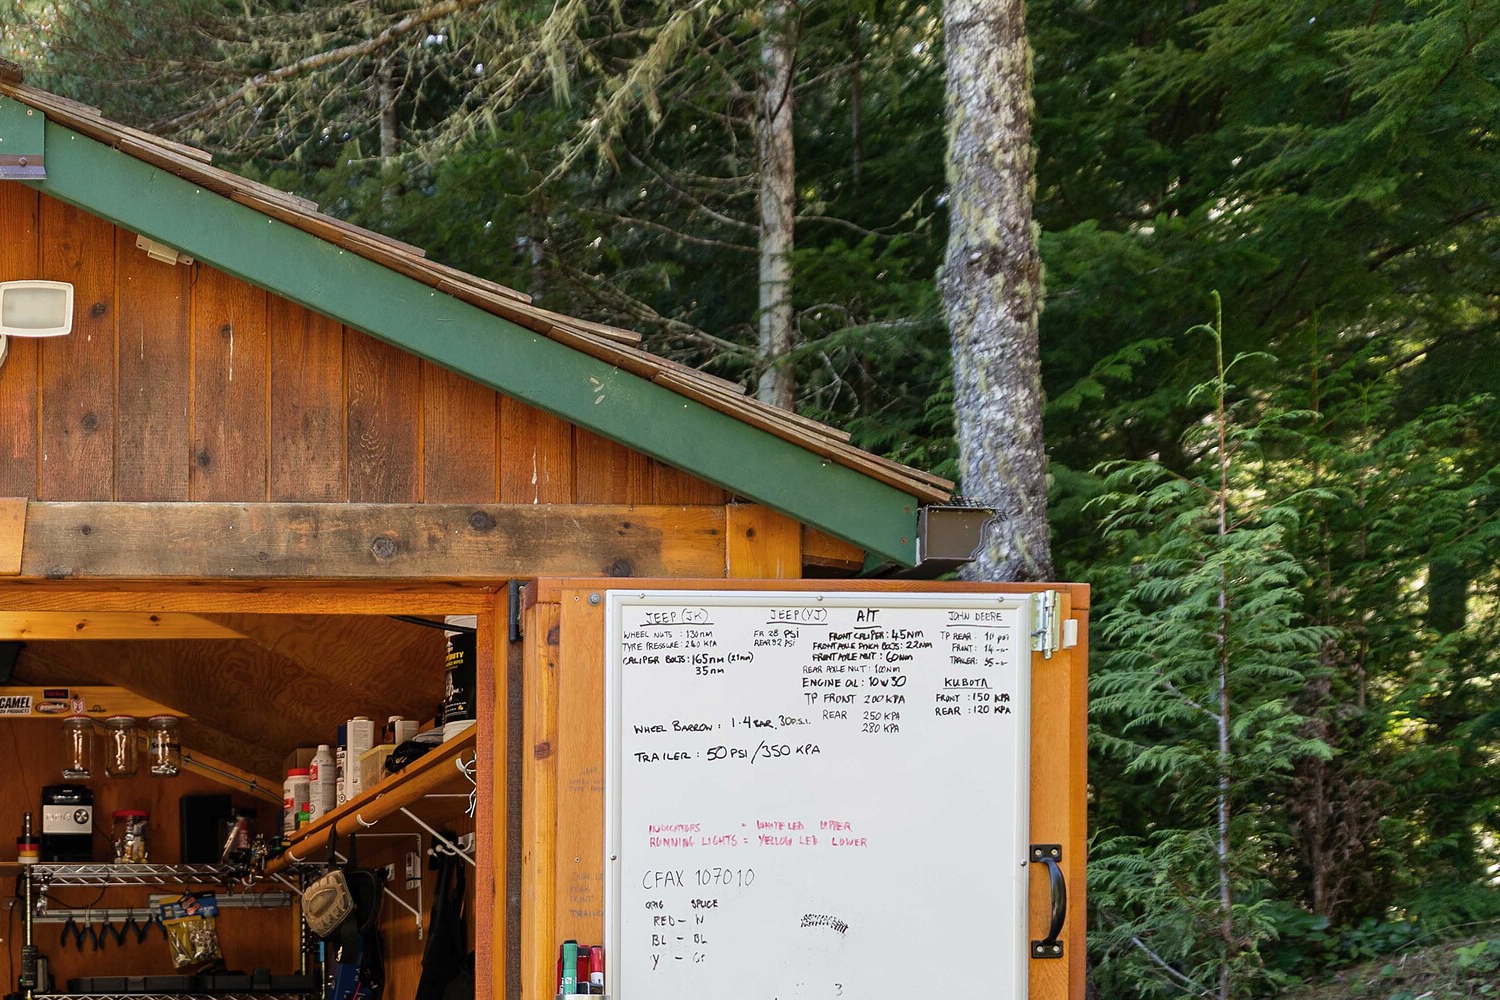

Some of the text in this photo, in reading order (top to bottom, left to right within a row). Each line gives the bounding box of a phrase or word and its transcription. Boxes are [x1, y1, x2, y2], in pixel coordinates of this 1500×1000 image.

[645, 611, 677, 624] JEEP
[975, 612, 1003, 622] DEERE
[623, 630, 649, 639] WHEEL
[753, 630, 765, 638] FR
[768, 629, 779, 637] 28
[828, 632, 853, 641] FRONT
[940, 631, 950, 640] TP
[622, 642, 643, 652] TYRE
[622, 656, 660, 665] CALIPER
[812, 653, 838, 662] FRONT
[838, 652, 857, 661] AXLE
[802, 666, 822, 674] REAR
[826, 665, 845, 673] AXLE
[802, 677, 841, 688] ENGINE
[944, 677, 988, 689] KUBOTA
[804, 692, 818, 705] TP
[823, 693, 856, 704] FRONT
[935, 693, 960, 702] FRONT
[994, 693, 1010, 703] KPA
[822, 710, 901, 721] REAR 250 KPA
[935, 707, 961, 717] REAR
[994, 705, 1011, 715] KPA
[634, 724, 667, 735] WHEEL
[672, 720, 713, 732] BARROW
[861, 723, 900, 733] 280 KPA
[634, 751, 691, 762] TRAILER
[795, 744, 821, 755] KPA
[650, 835, 868, 848] RUNNING LIGHTS YELLOW LED LOWER
[642, 869, 685, 890] CFAX
[691, 899, 718, 908] SPLICE
